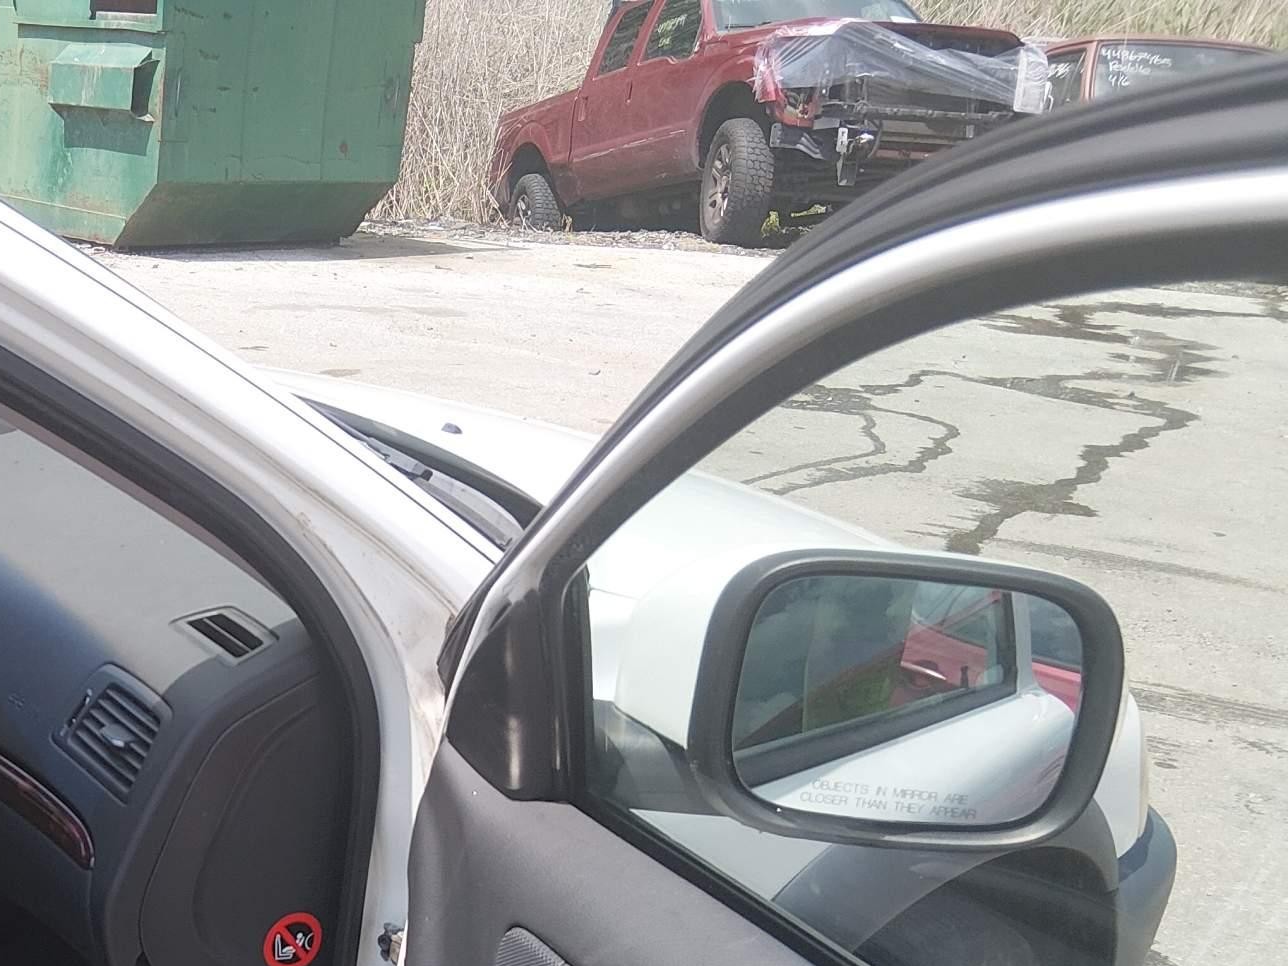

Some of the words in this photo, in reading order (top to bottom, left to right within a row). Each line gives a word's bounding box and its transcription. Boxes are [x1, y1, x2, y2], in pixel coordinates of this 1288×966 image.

[799, 791, 848, 806] CLOSER
[855, 796, 887, 810] THAN
[894, 801, 924, 814] THEY
[929, 805, 977, 819] APPEAR
[812, 779, 869, 795] OBJECTS
[876, 785, 886, 797] IN
[893, 787, 938, 801] MIRROR
[943, 793, 968, 805] ARE
